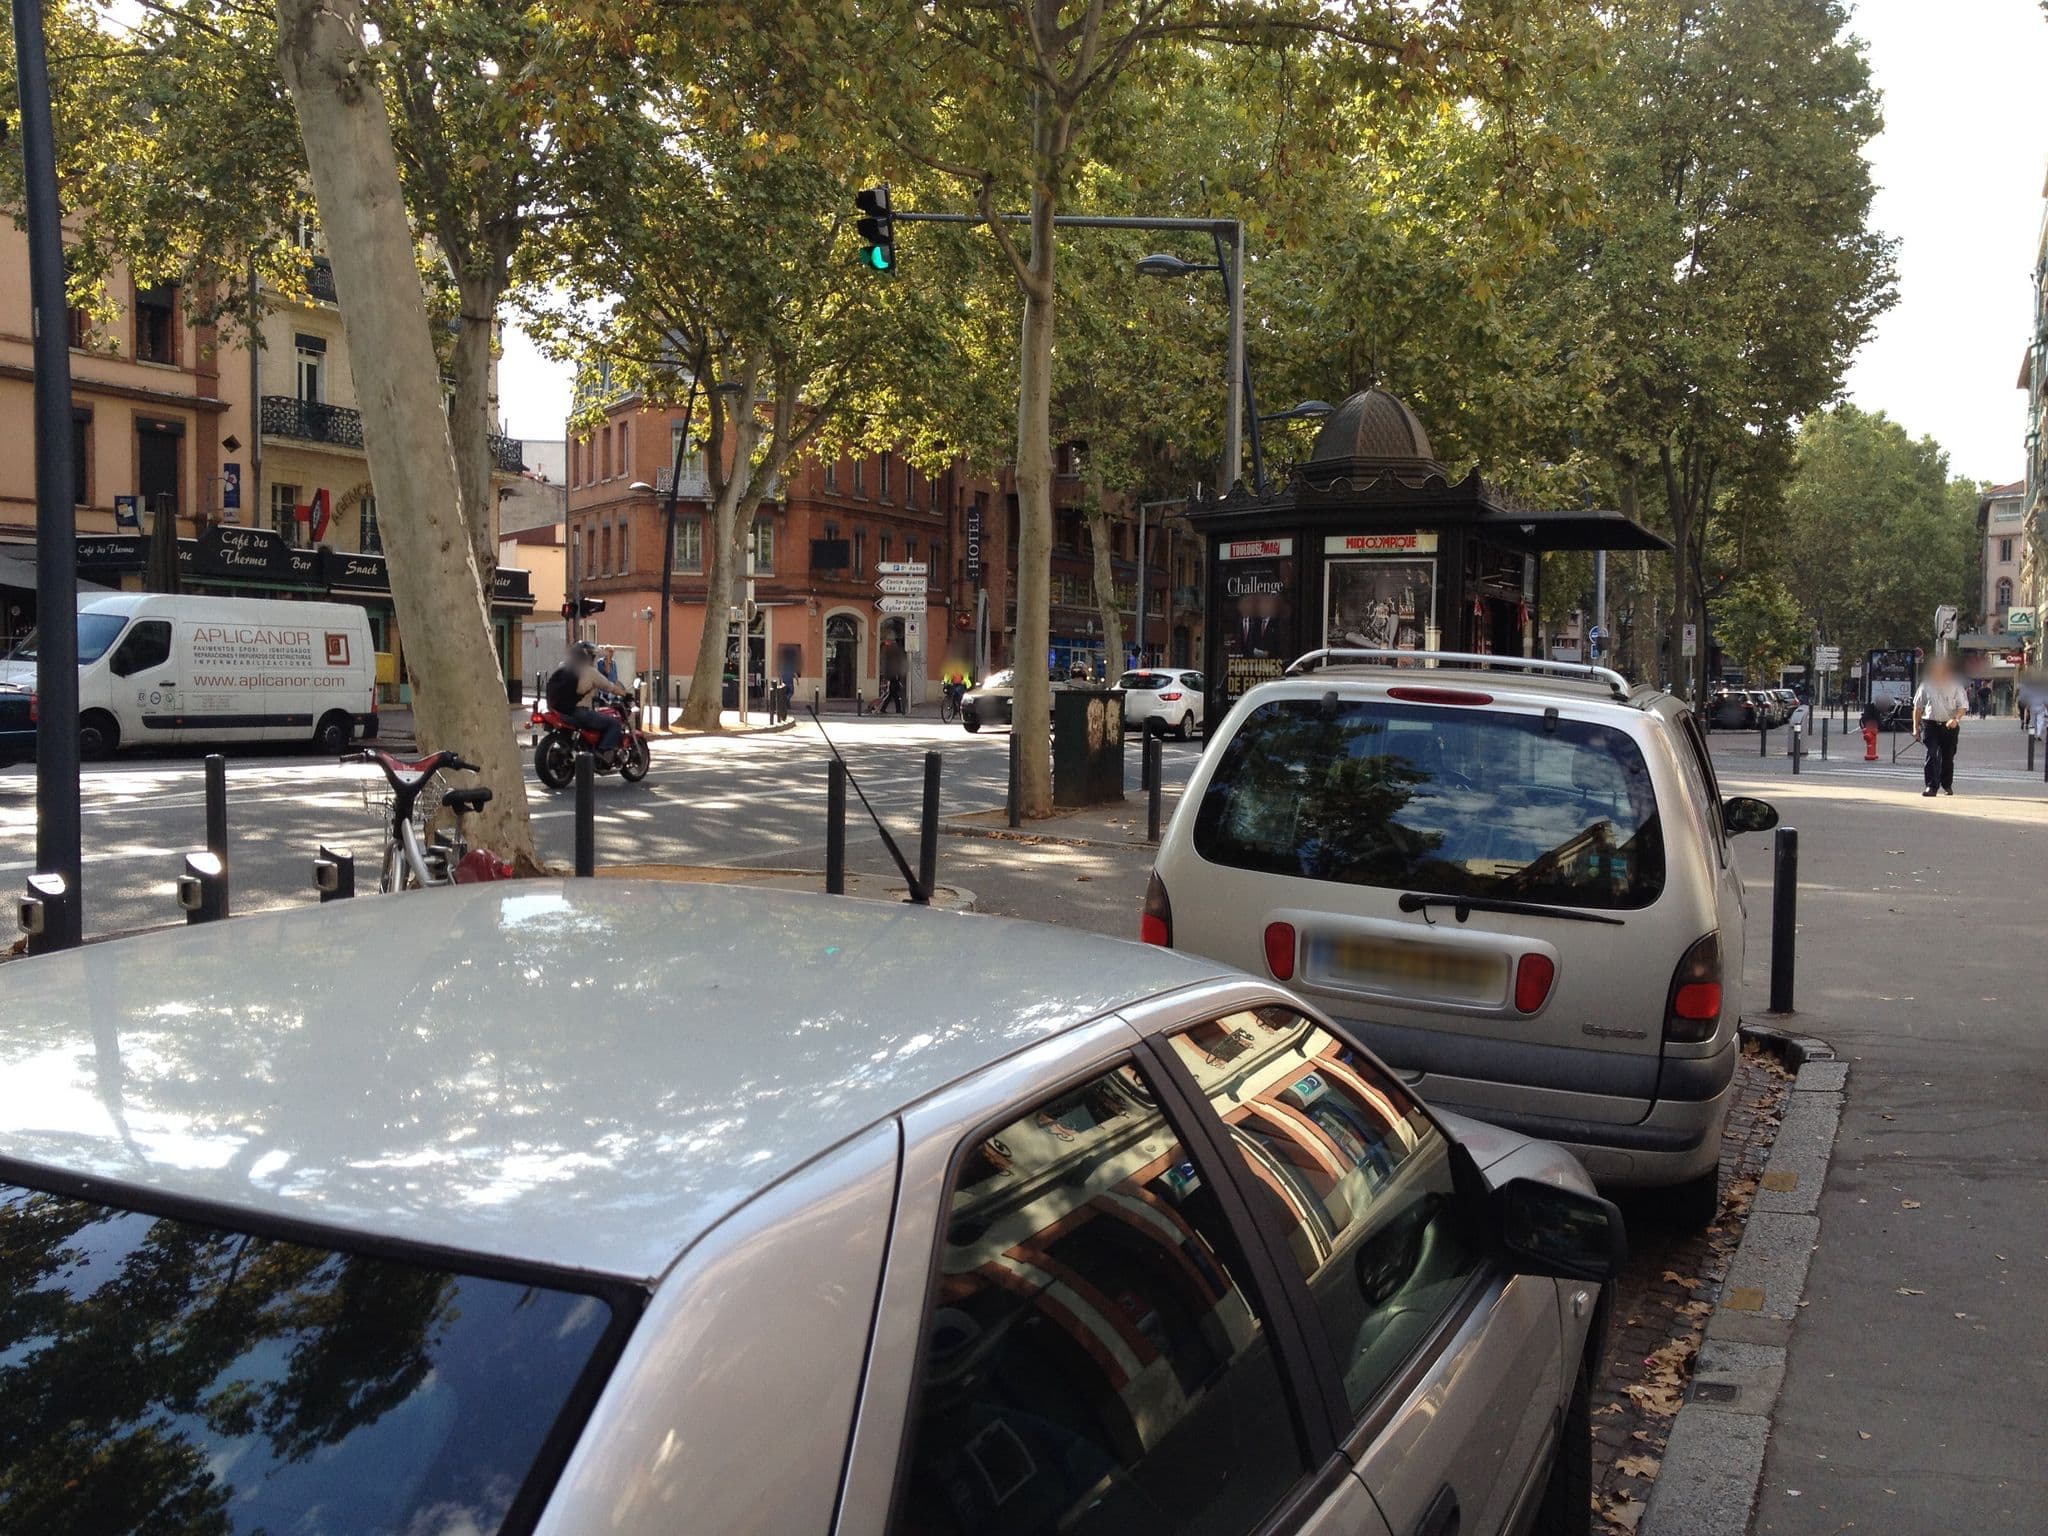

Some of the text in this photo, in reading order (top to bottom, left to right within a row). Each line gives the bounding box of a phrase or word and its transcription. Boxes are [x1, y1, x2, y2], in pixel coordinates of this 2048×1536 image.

[221, 530, 269, 549] Café des
[968, 513, 979, 569] HOTEL
[1346, 537, 1365, 549] MIDI
[78, 545, 94, 557] Café
[106, 543, 135, 554] Thermes
[219, 549, 267, 567] Thermes
[290, 556, 312, 571] Bar
[345, 560, 378, 576] Snack
[193, 628, 311, 646] APLICANOR
[194, 659, 312, 667] IMPERMEABILIZACIONES
[1228, 658, 1283, 677] FORTUNES
[193, 673, 346, 690] www.aplicanor.com
[1228, 677, 1241, 692] DE
